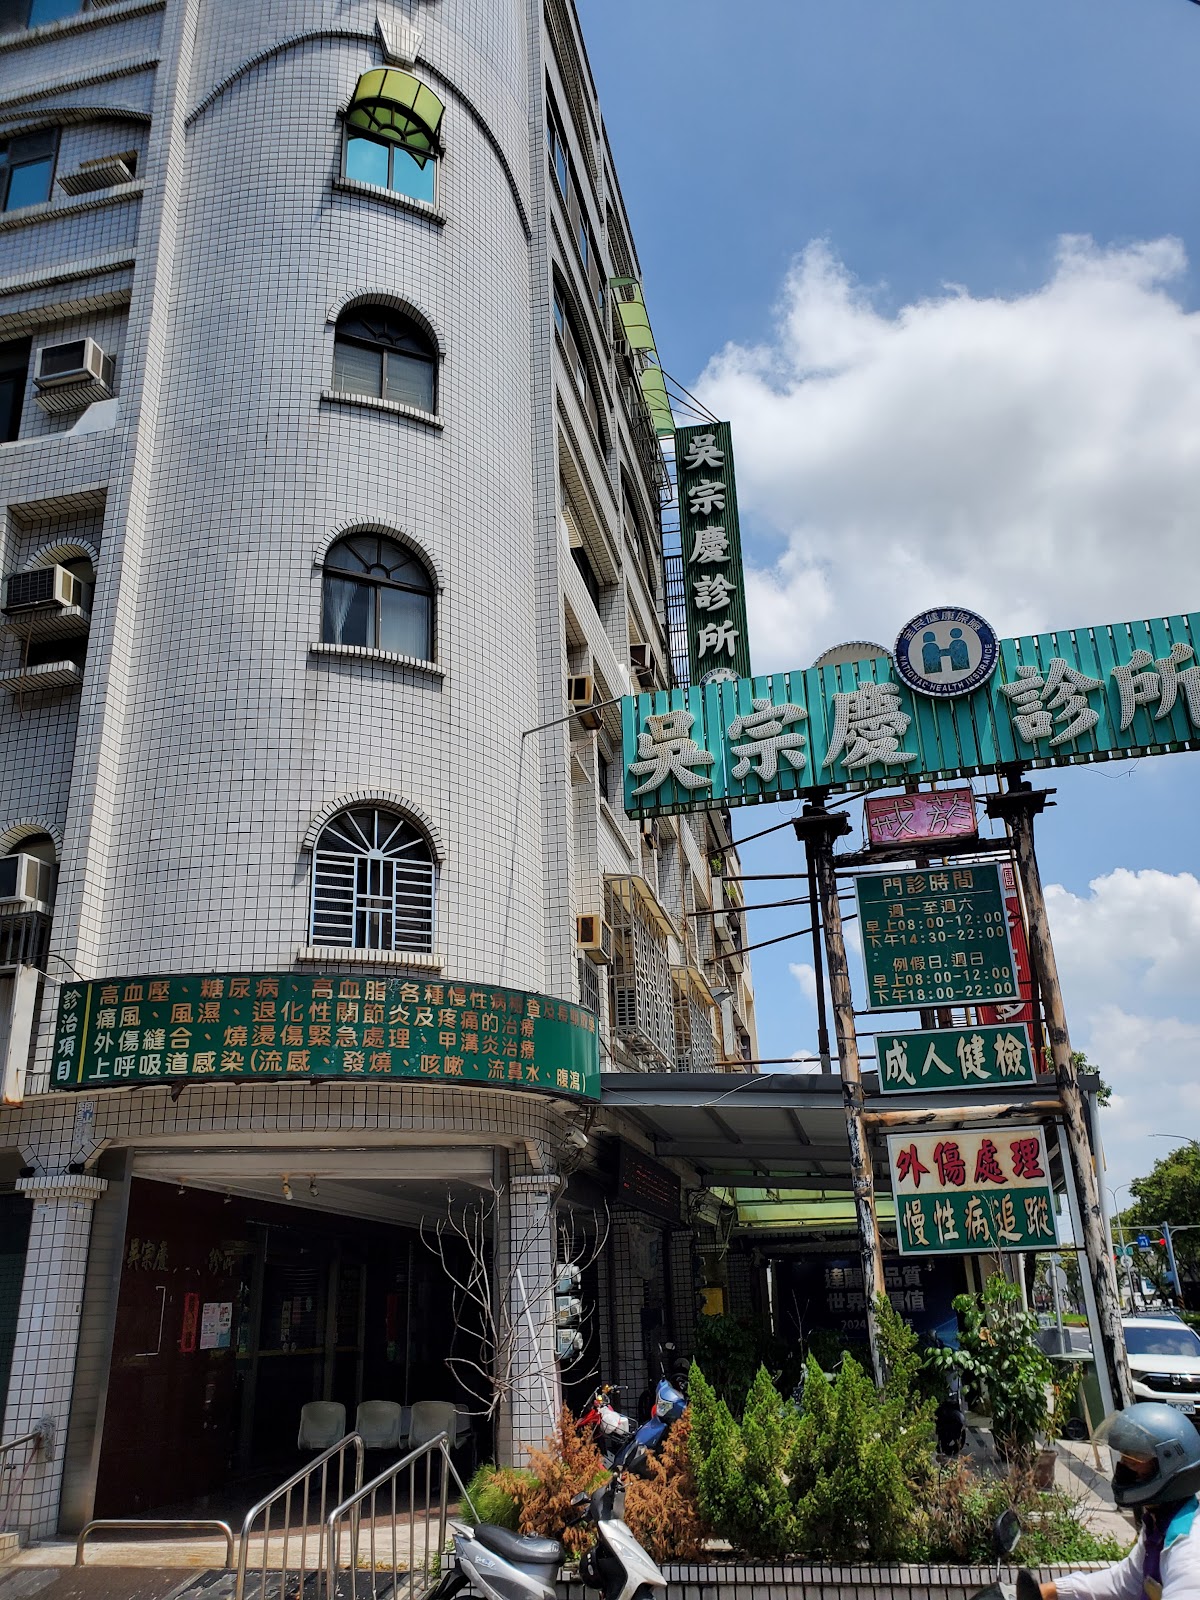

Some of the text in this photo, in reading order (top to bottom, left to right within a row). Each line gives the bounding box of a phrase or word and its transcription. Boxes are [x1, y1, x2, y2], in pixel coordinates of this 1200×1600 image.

[684, 433, 739, 659] 吳宗慶診所
[902, 611, 983, 642] 全民健康保險
[929, 682, 964, 692] HEALTH
[965, 643, 993, 686] INSURANCE
[882, 869, 974, 897] 門診時間
[888, 898, 974, 918] 週一至週六
[57, 989, 83, 1081] 診治項目
[885, 1032, 1027, 1086] 成人健檢
[897, 1136, 1046, 1188] 外傷處理
[903, 1194, 1054, 1247] 慢性病追蹤
